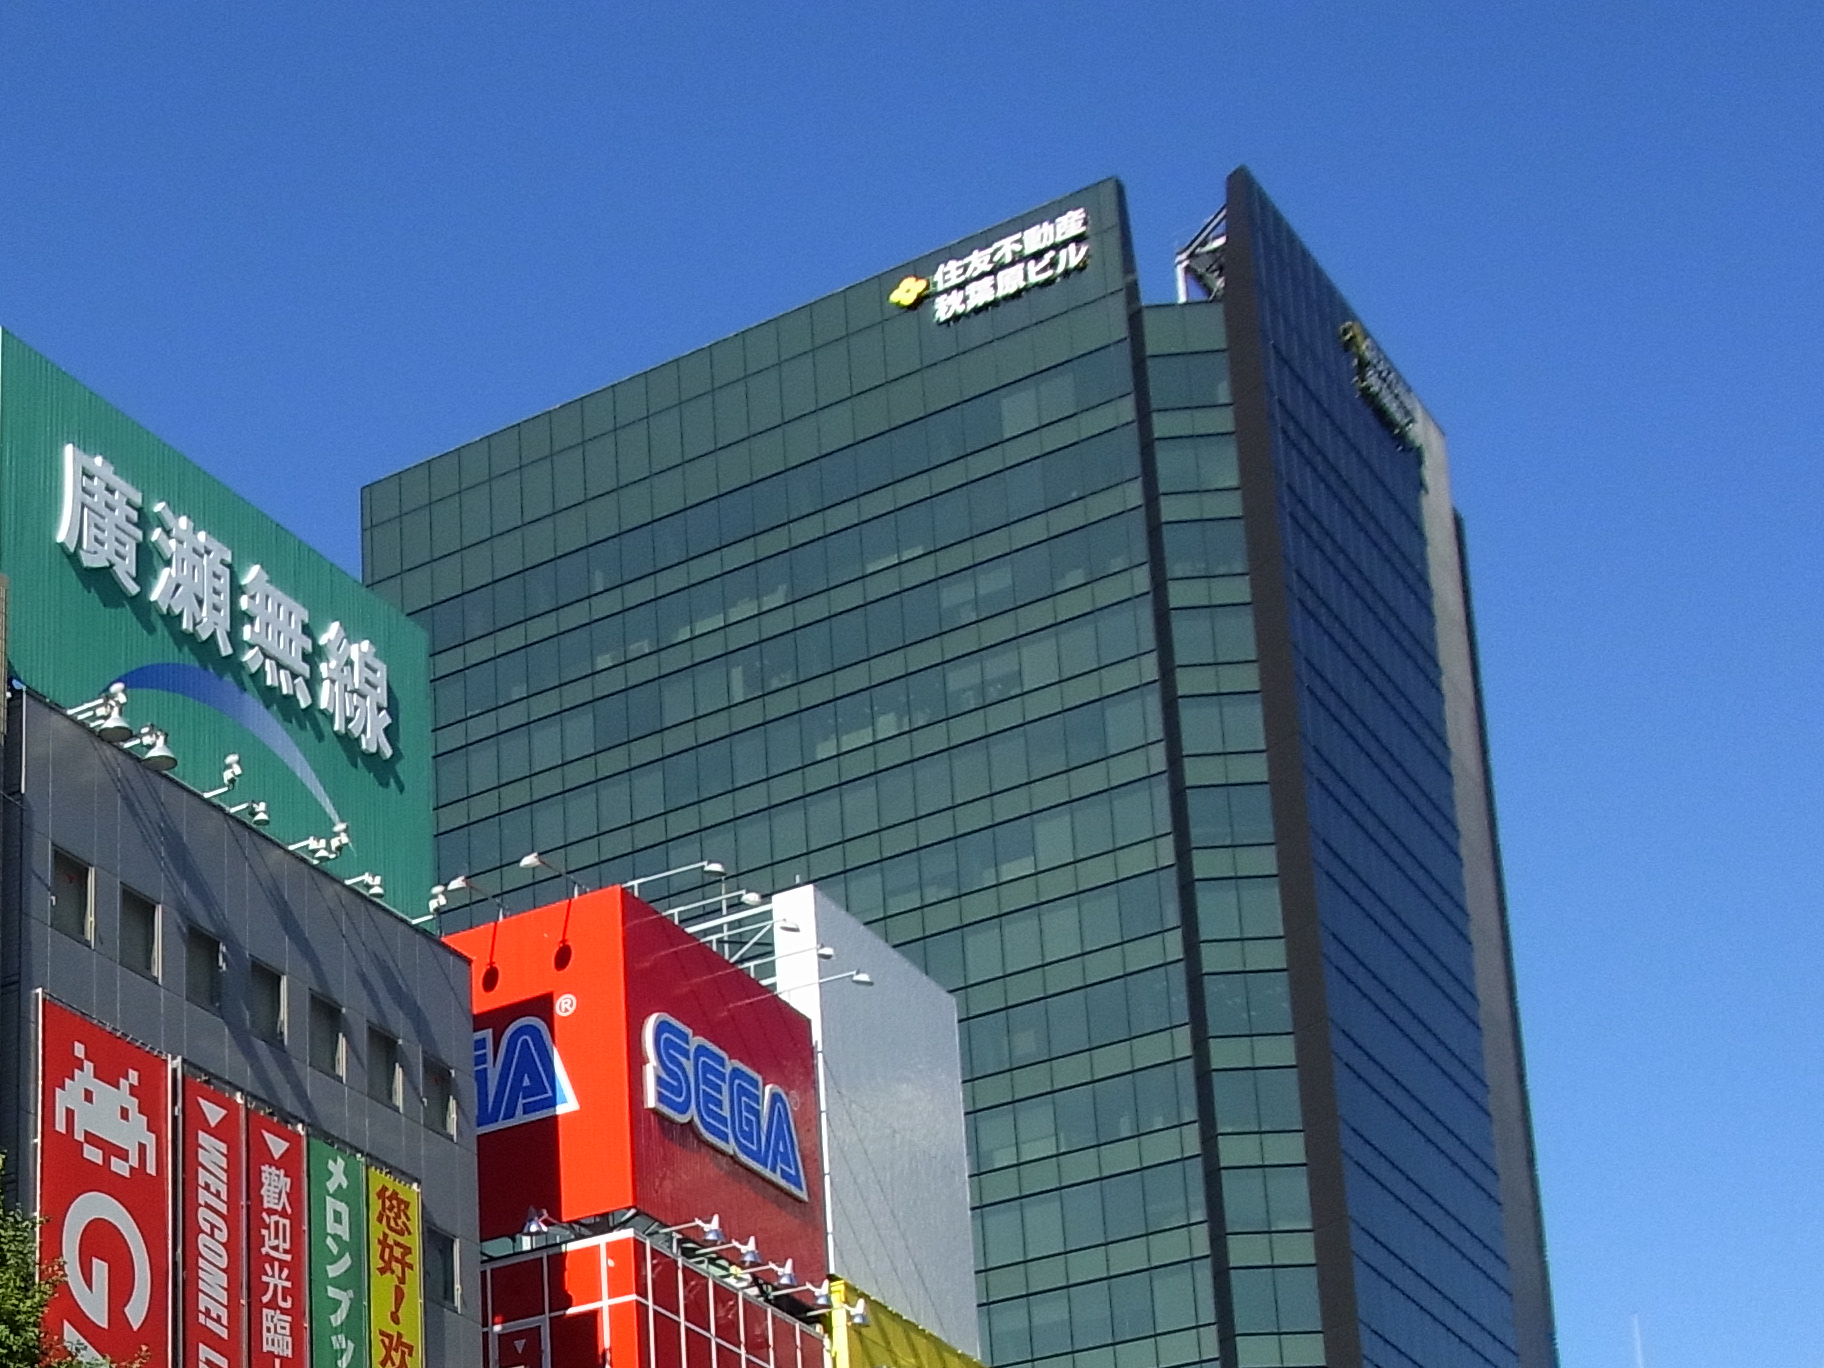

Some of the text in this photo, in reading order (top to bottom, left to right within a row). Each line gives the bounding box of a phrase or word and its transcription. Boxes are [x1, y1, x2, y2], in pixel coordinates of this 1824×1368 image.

[934, 207, 1087, 290] 住友不動産
[934, 243, 1089, 323] 秋葉原ビル
[56, 444, 394, 762] 廣瀬無線
[642, 1012, 808, 1202] SEGA
[197, 1130, 229, 1340] WELCOME!
